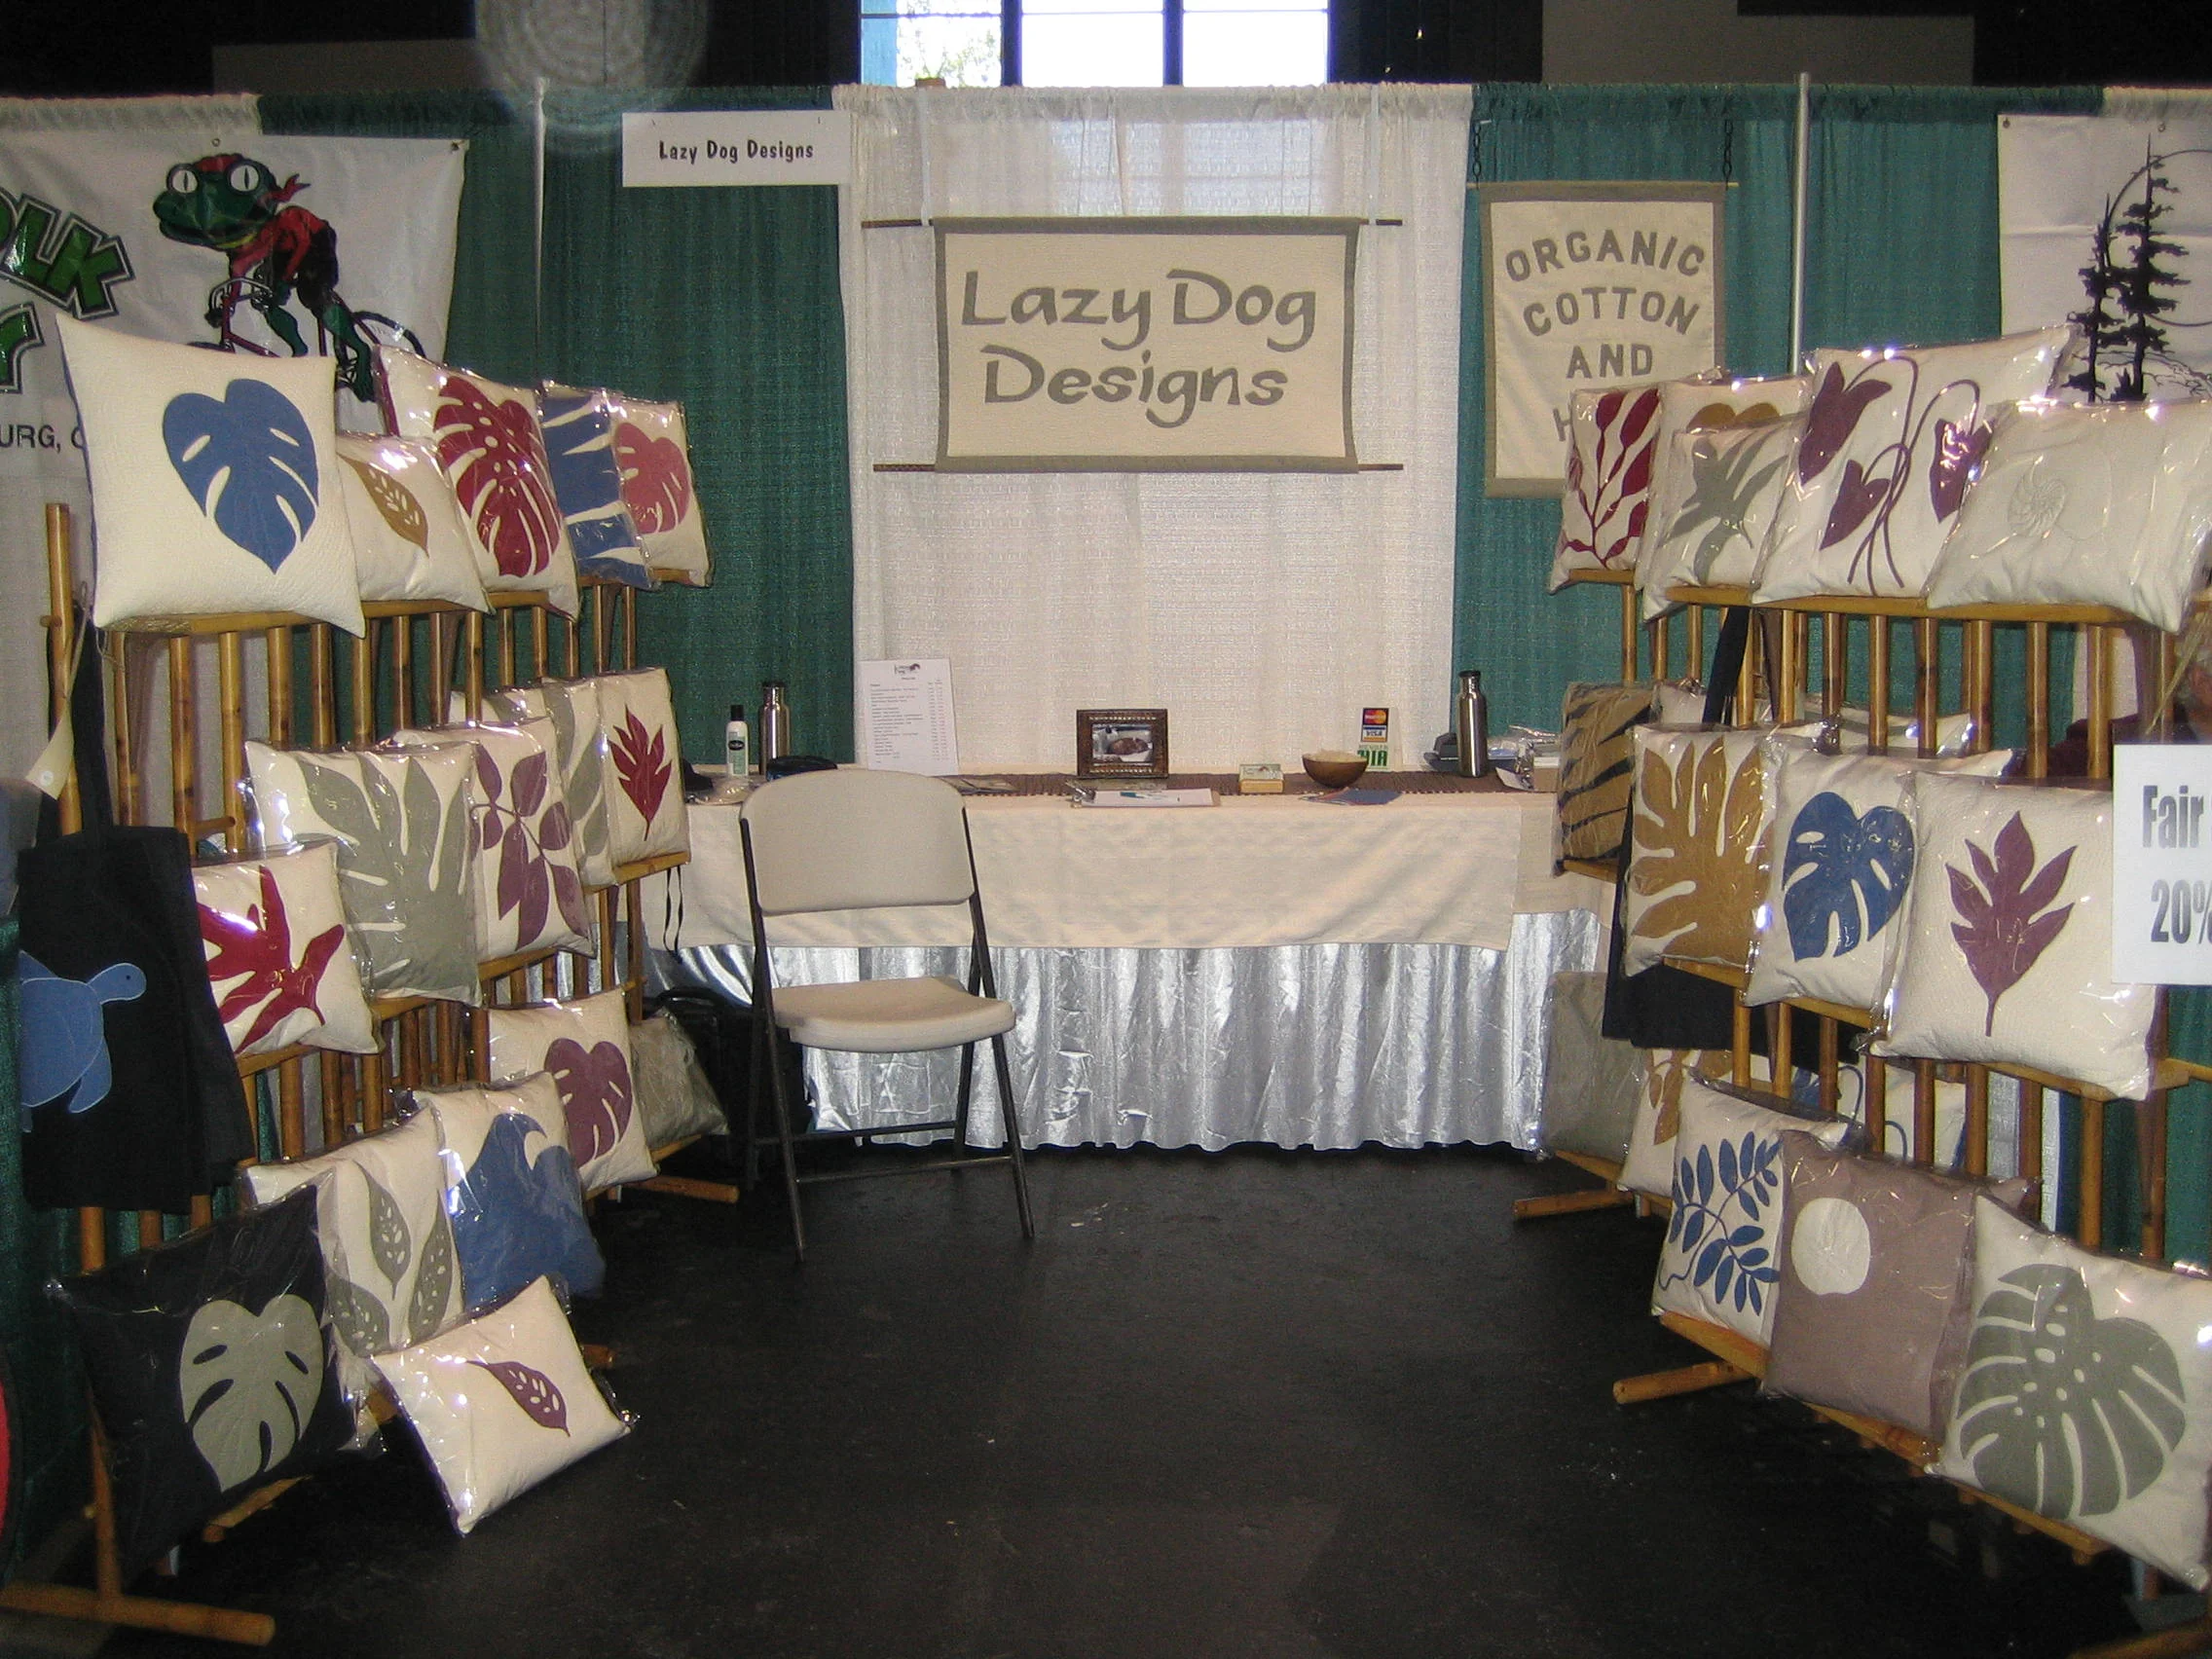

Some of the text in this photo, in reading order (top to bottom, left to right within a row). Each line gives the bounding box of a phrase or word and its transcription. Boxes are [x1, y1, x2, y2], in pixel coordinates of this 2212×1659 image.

[659, 139, 814, 165] Lazy Dog Designs
[1505, 229, 1705, 282] ORGANIC
[961, 269, 1316, 352] Lazy Dog
[1523, 286, 1700, 337] COTTON
[979, 344, 1289, 428] Designs
[1566, 344, 1653, 379] AND
[2143, 785, 2204, 848] Fair
